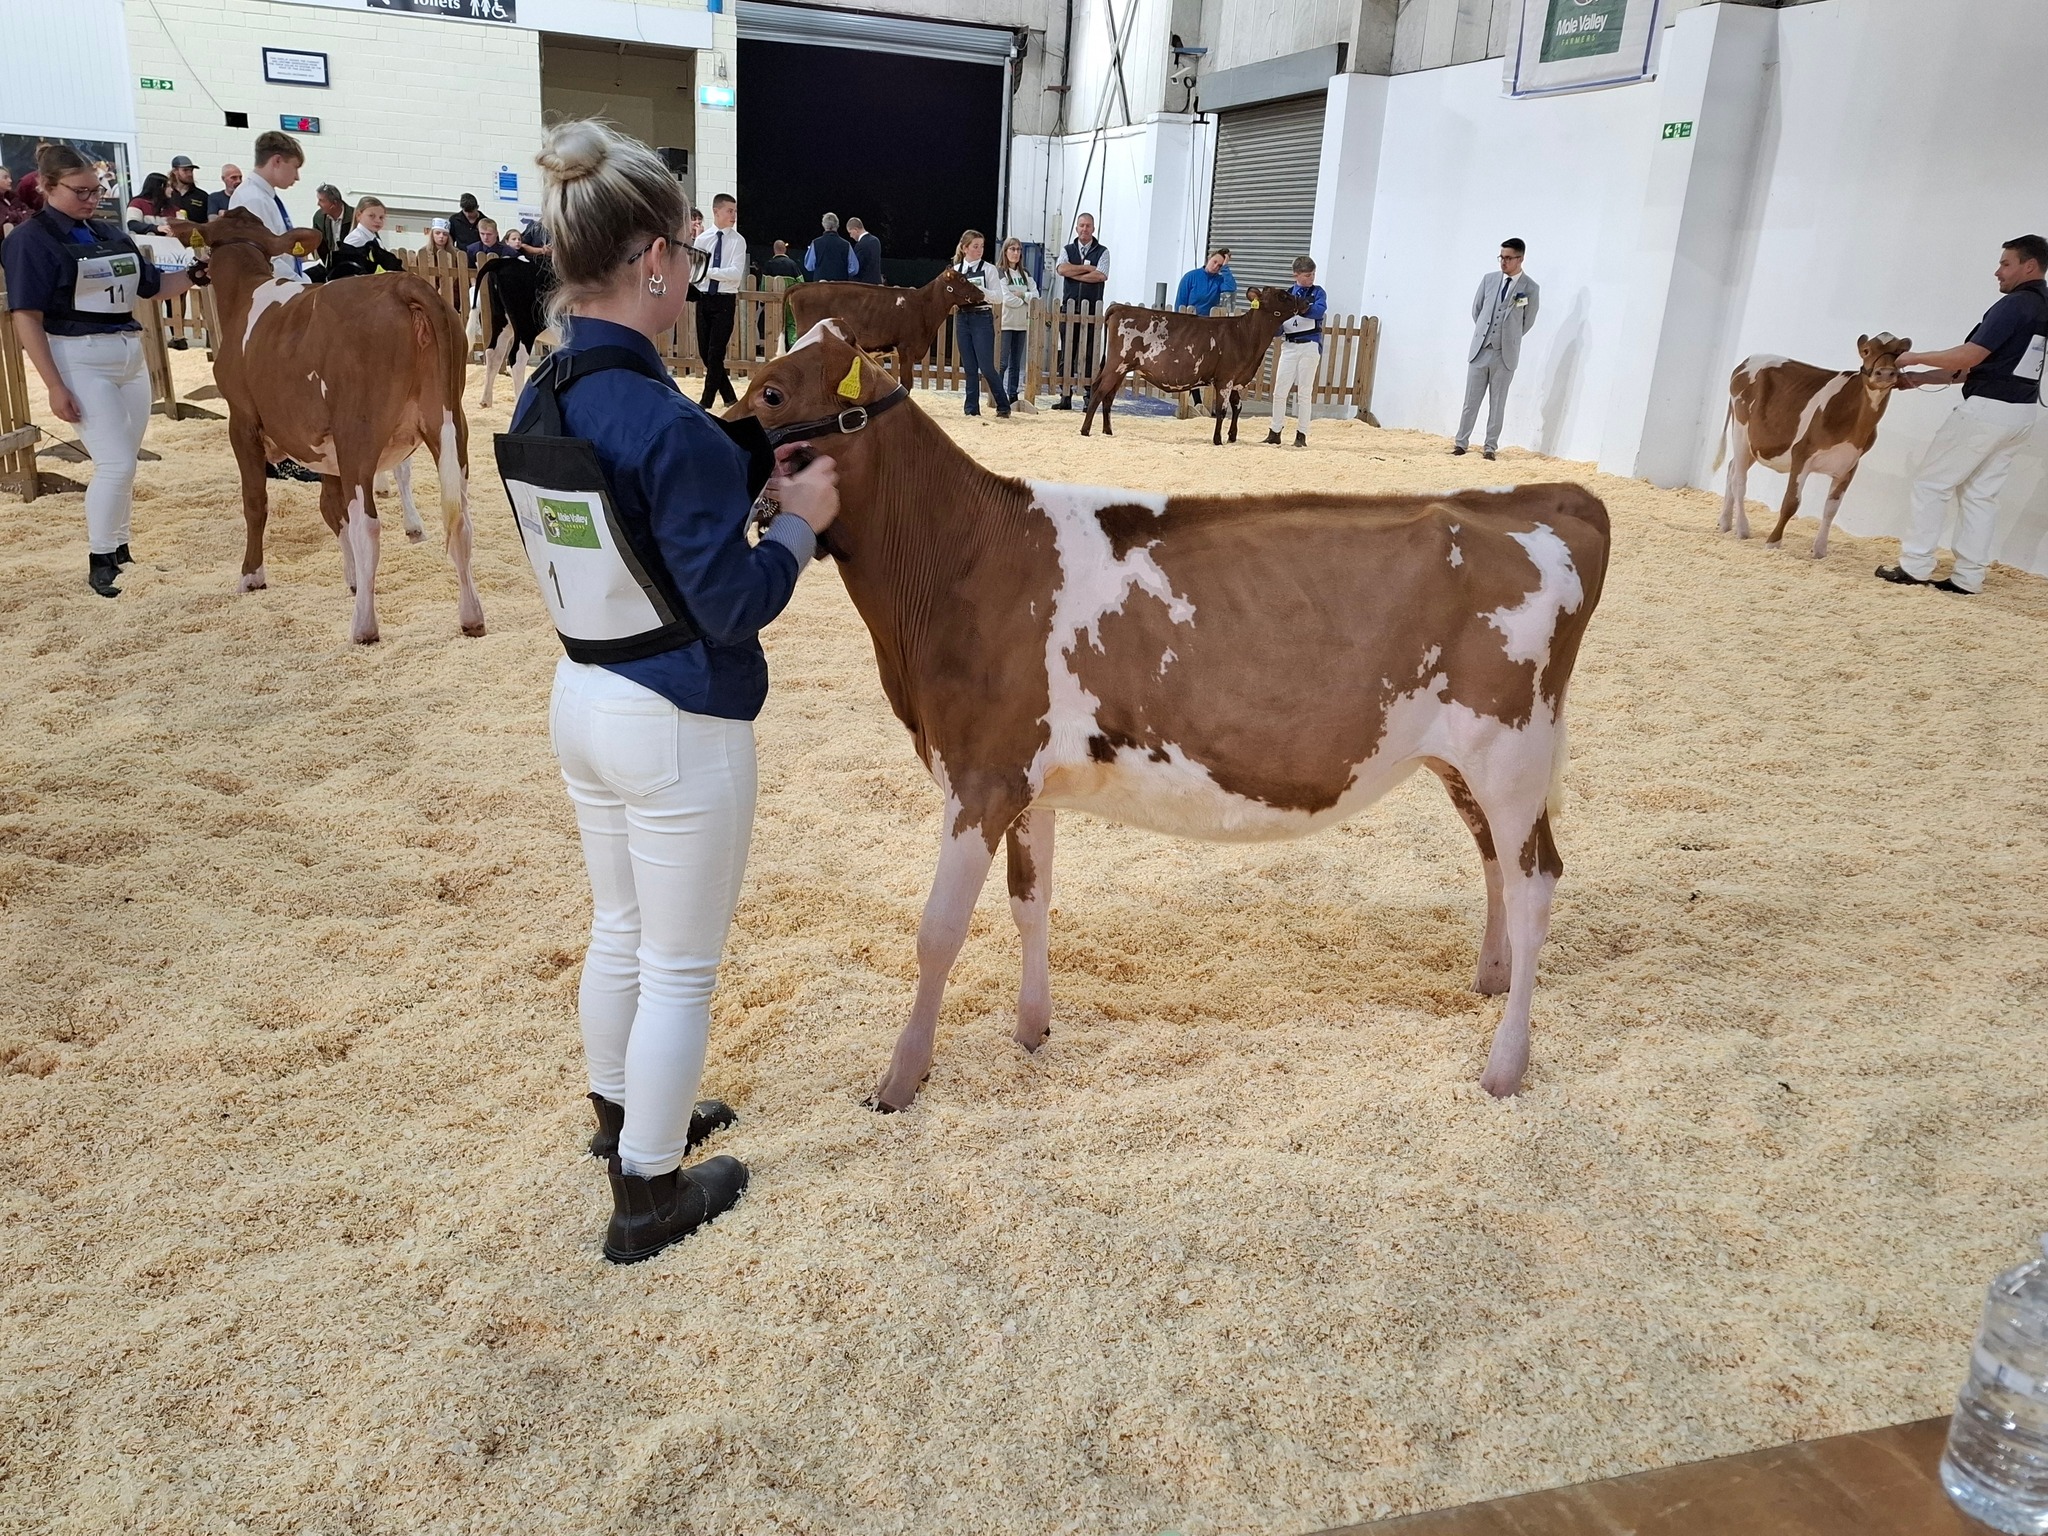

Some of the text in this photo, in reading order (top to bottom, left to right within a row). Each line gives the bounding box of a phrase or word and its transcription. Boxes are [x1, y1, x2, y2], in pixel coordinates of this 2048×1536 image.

[1556, 13, 1608, 36] Mole Valley
[1561, 34, 1596, 46] FARMERS
[104, 284, 125, 304] 11
[1292, 319, 1299, 327] 4
[569, 512, 587, 525] Valley
[548, 561, 564, 608] 1
